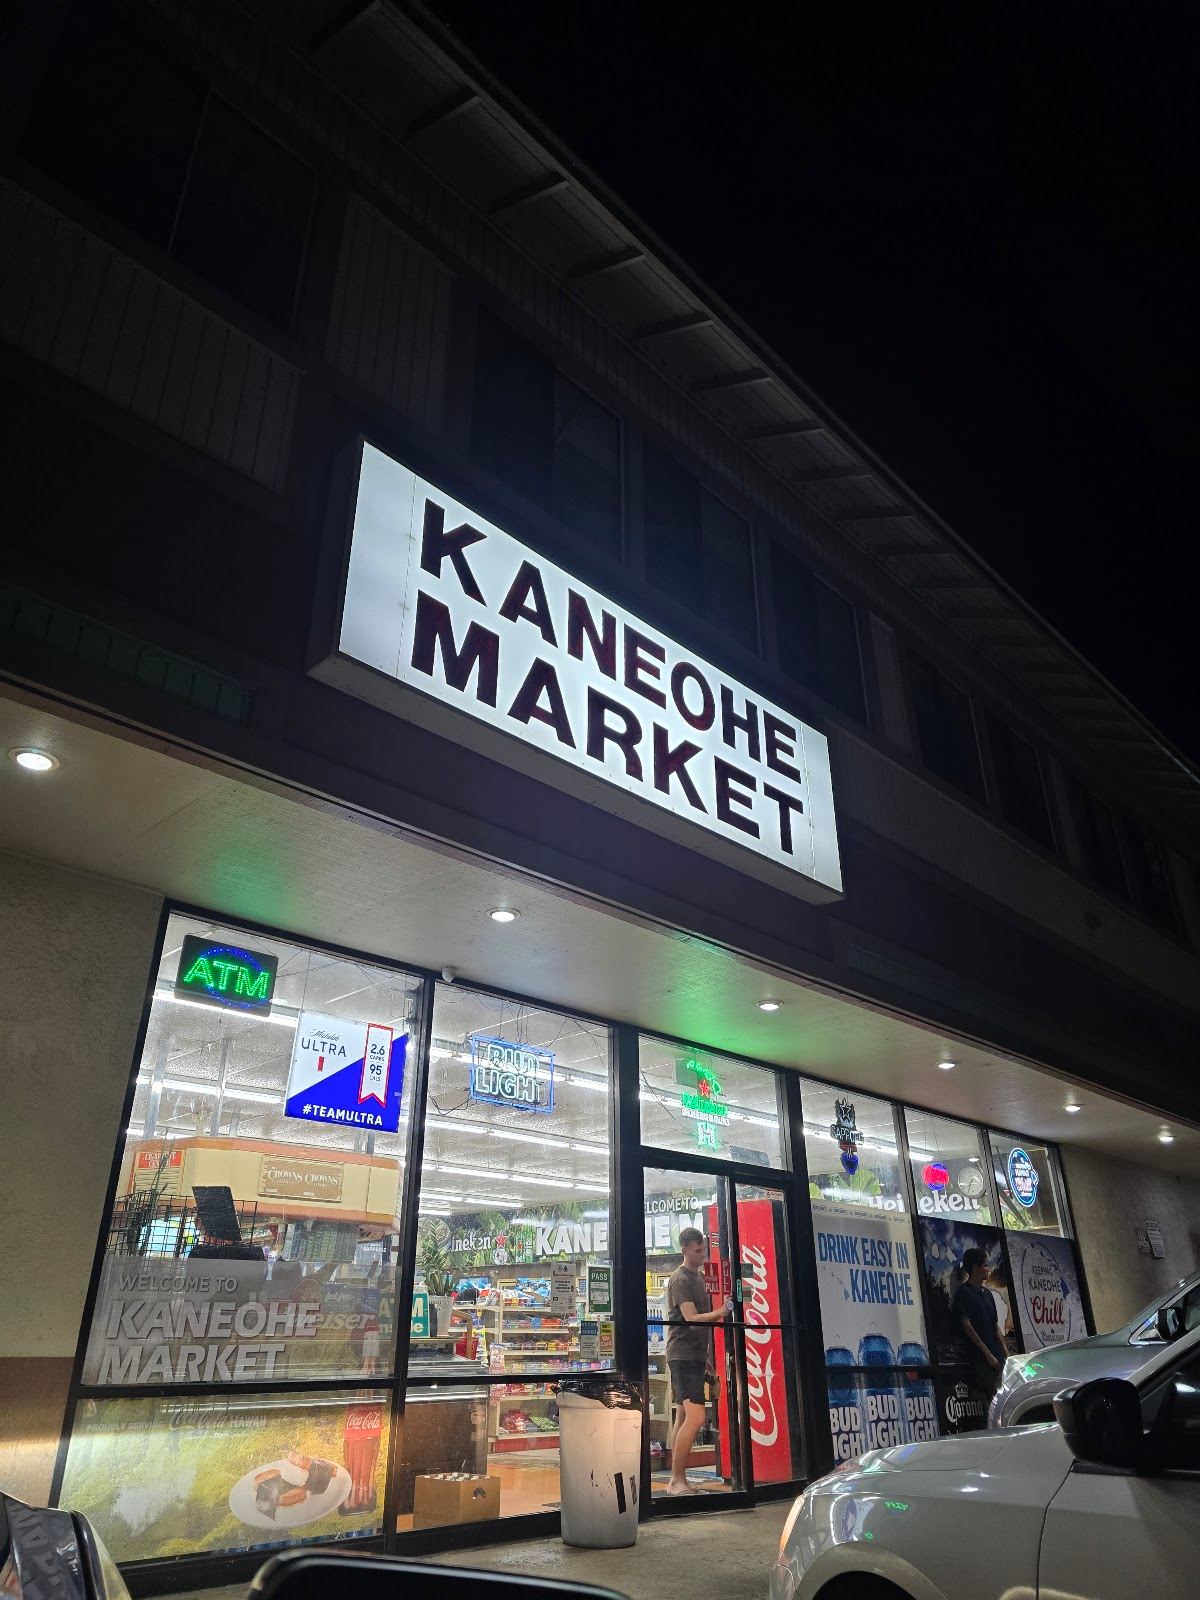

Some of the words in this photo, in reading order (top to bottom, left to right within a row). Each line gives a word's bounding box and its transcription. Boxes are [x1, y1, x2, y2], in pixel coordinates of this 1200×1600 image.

[420, 498, 802, 784] KANEOHE
[411, 589, 803, 856] MARKET
[184, 957, 269, 999] ATM
[301, 1037, 347, 1058] ULTRA
[370, 1043, 386, 1056] 2.6
[487, 1044, 540, 1074] BUD
[369, 1063, 383, 1076] 95
[475, 1066, 546, 1104] LIGHT
[302, 1103, 383, 1126] #TEAMULTRA
[683, 1196, 700, 1211] TO
[817, 1232, 860, 1265] DRINK
[861, 1238, 892, 1268] EASY
[895, 1241, 909, 1269] IN
[119, 1275, 210, 1292] WELCOME
[216, 1277, 238, 1292] TO
[591, 1272, 608, 1281] PASS
[705, 1282, 720, 1293] PULL
[722, 1261, 730, 1293] PULL
[849, 1268, 914, 1306] KANEOHE
[1028, 1278, 1061, 1292] KANEOHE
[106, 1300, 321, 1339] KANEOHE
[1030, 1295, 1065, 1325] Chill
[97, 1343, 286, 1385] MARKET
[829, 1407, 861, 1433] BUD
[866, 1394, 898, 1421] BUD
[905, 1396, 934, 1421] BUD
[946, 1396, 984, 1425] Corona
[832, 1432, 867, 1461] IGHT
